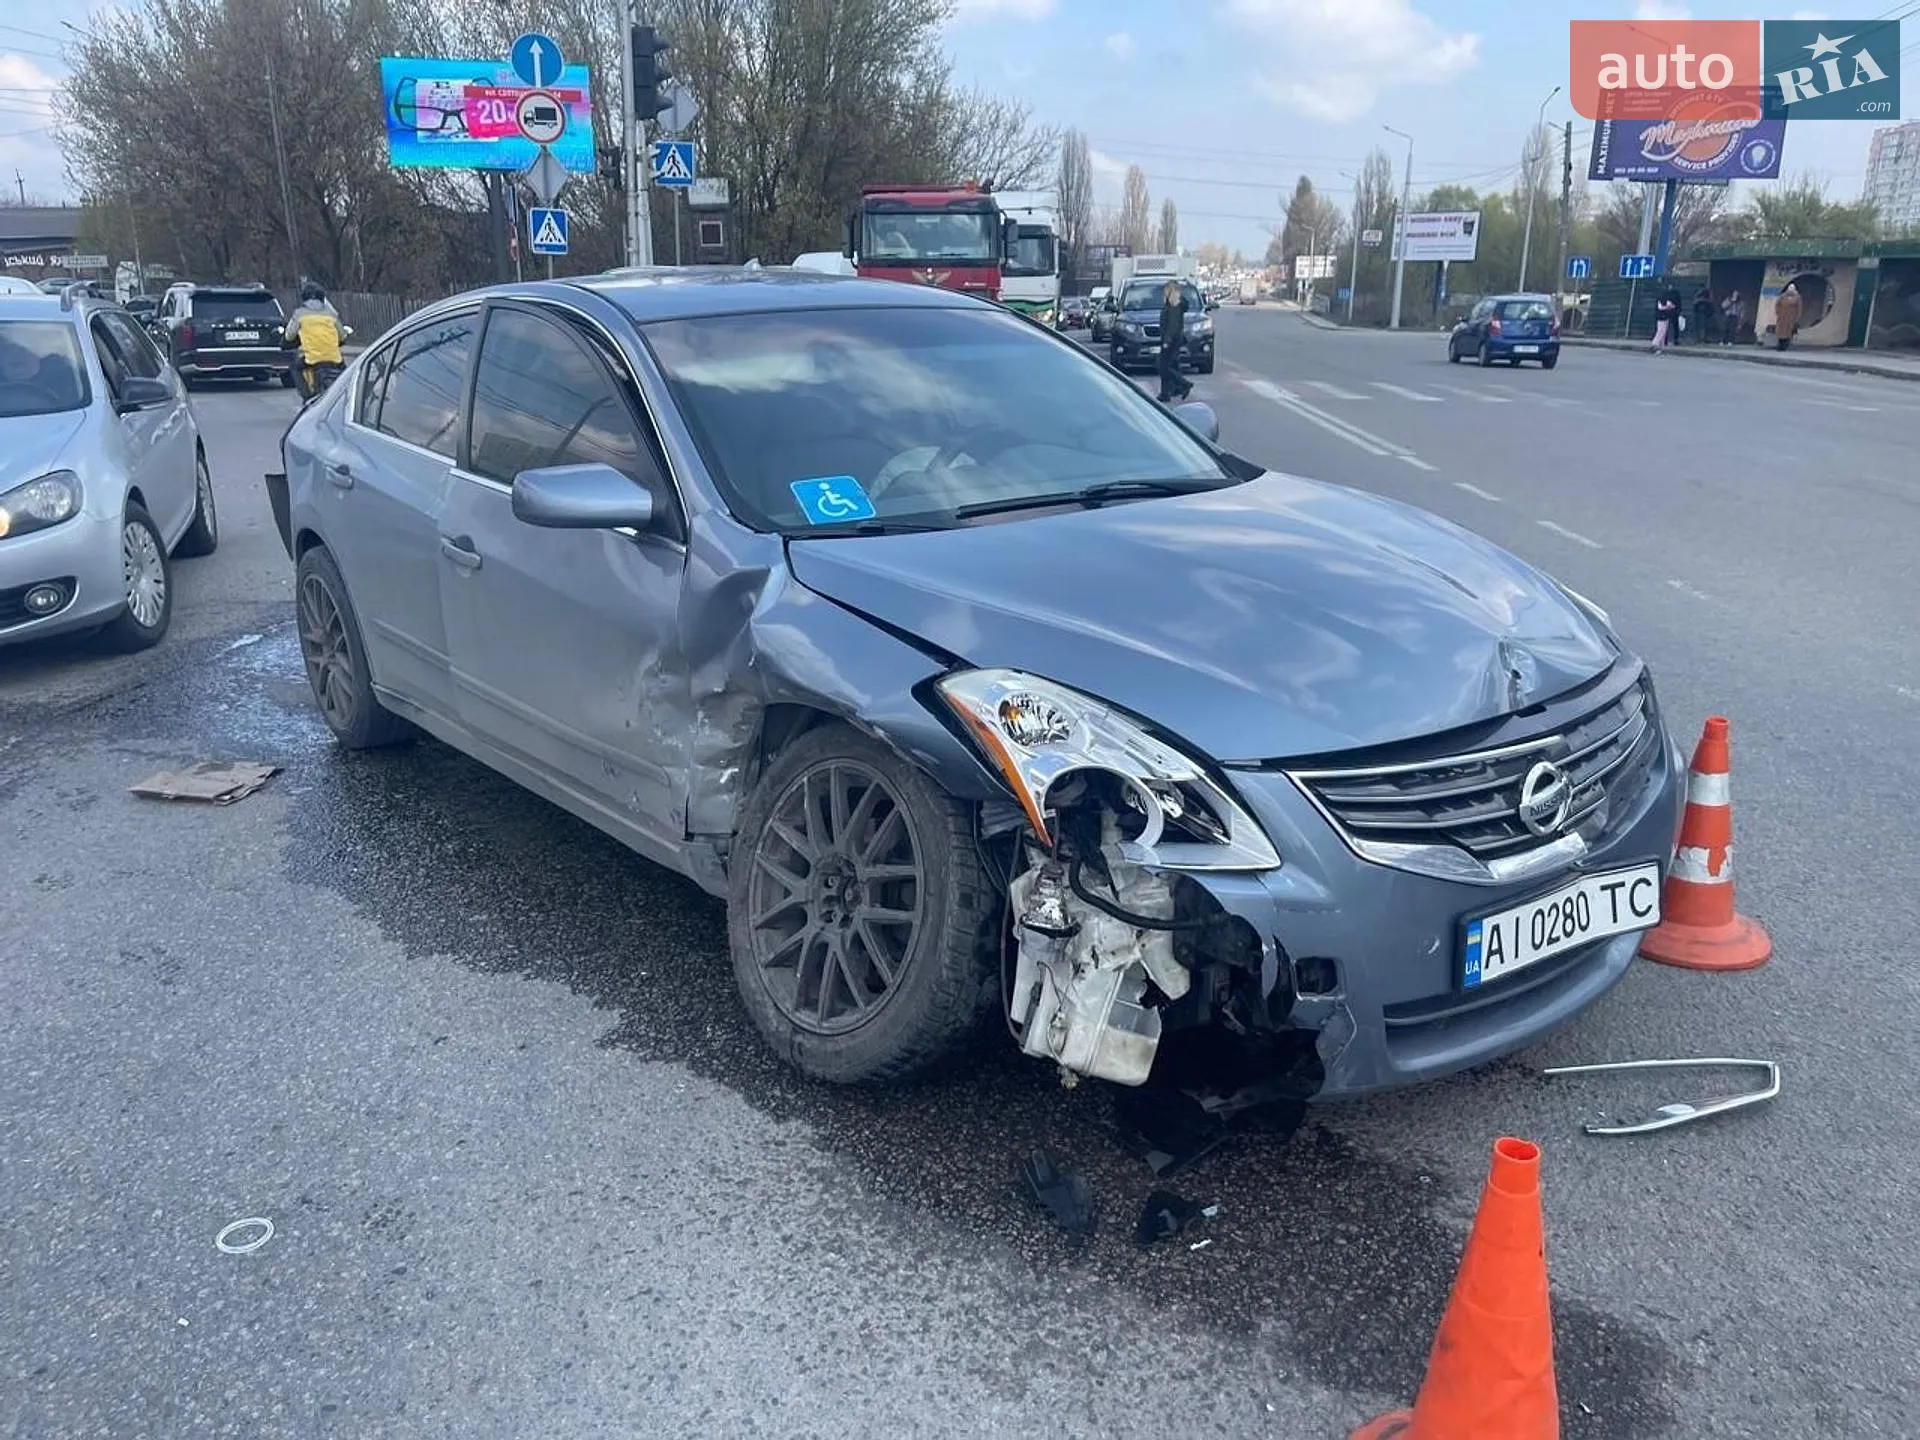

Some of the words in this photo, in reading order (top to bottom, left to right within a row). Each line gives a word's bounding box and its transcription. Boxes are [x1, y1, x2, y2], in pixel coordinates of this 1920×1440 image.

[1484, 916, 1520, 970] AI
[1531, 890, 1591, 952] 0280
[1600, 877, 1653, 924] TC
[1464, 961, 1481, 975] UA
